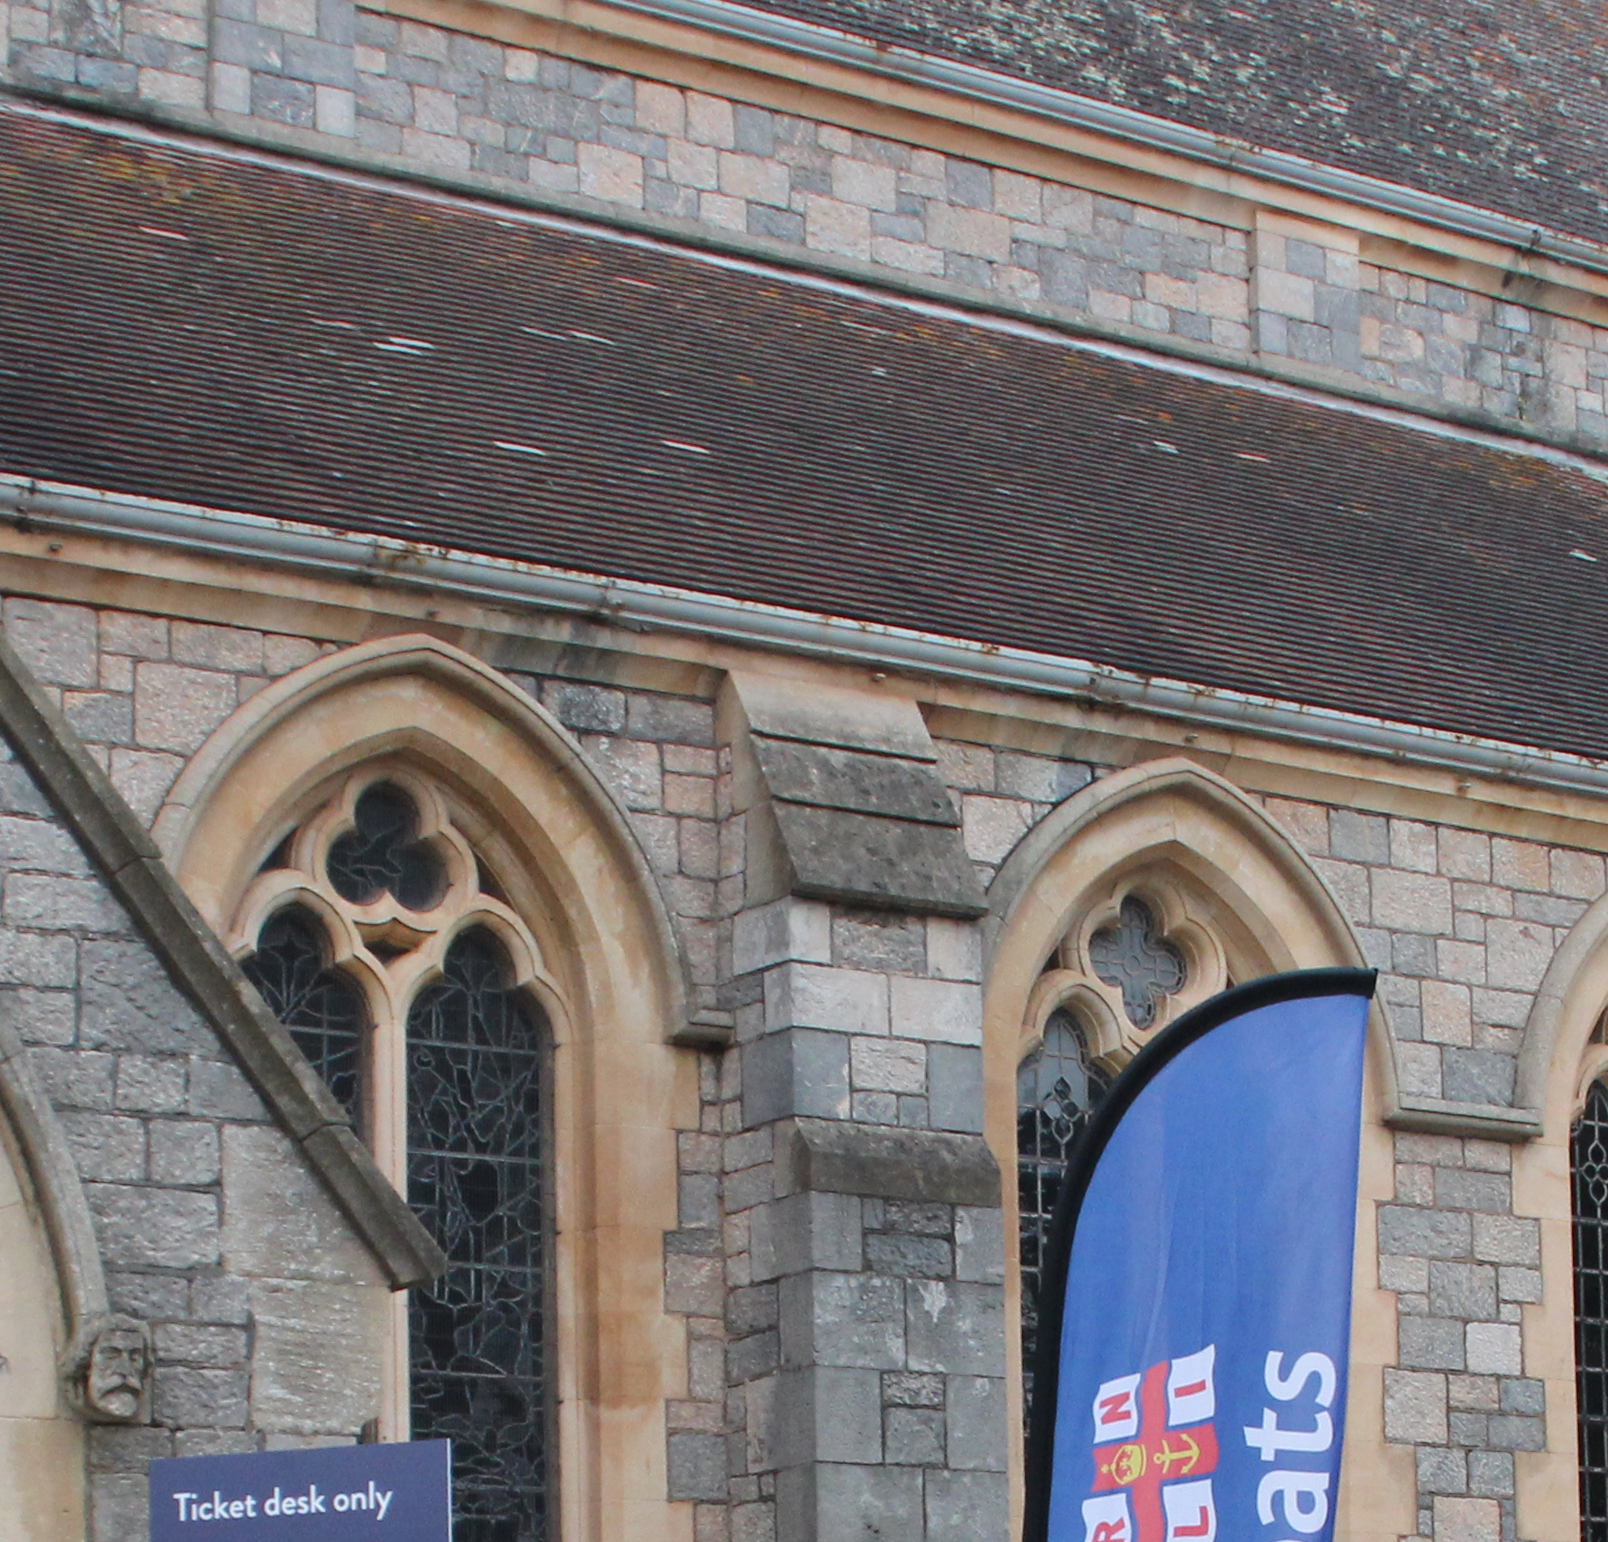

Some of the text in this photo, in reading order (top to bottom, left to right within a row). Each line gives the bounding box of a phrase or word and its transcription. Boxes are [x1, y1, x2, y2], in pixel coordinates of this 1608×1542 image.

[173, 1481, 393, 1521] Ticket desk only
